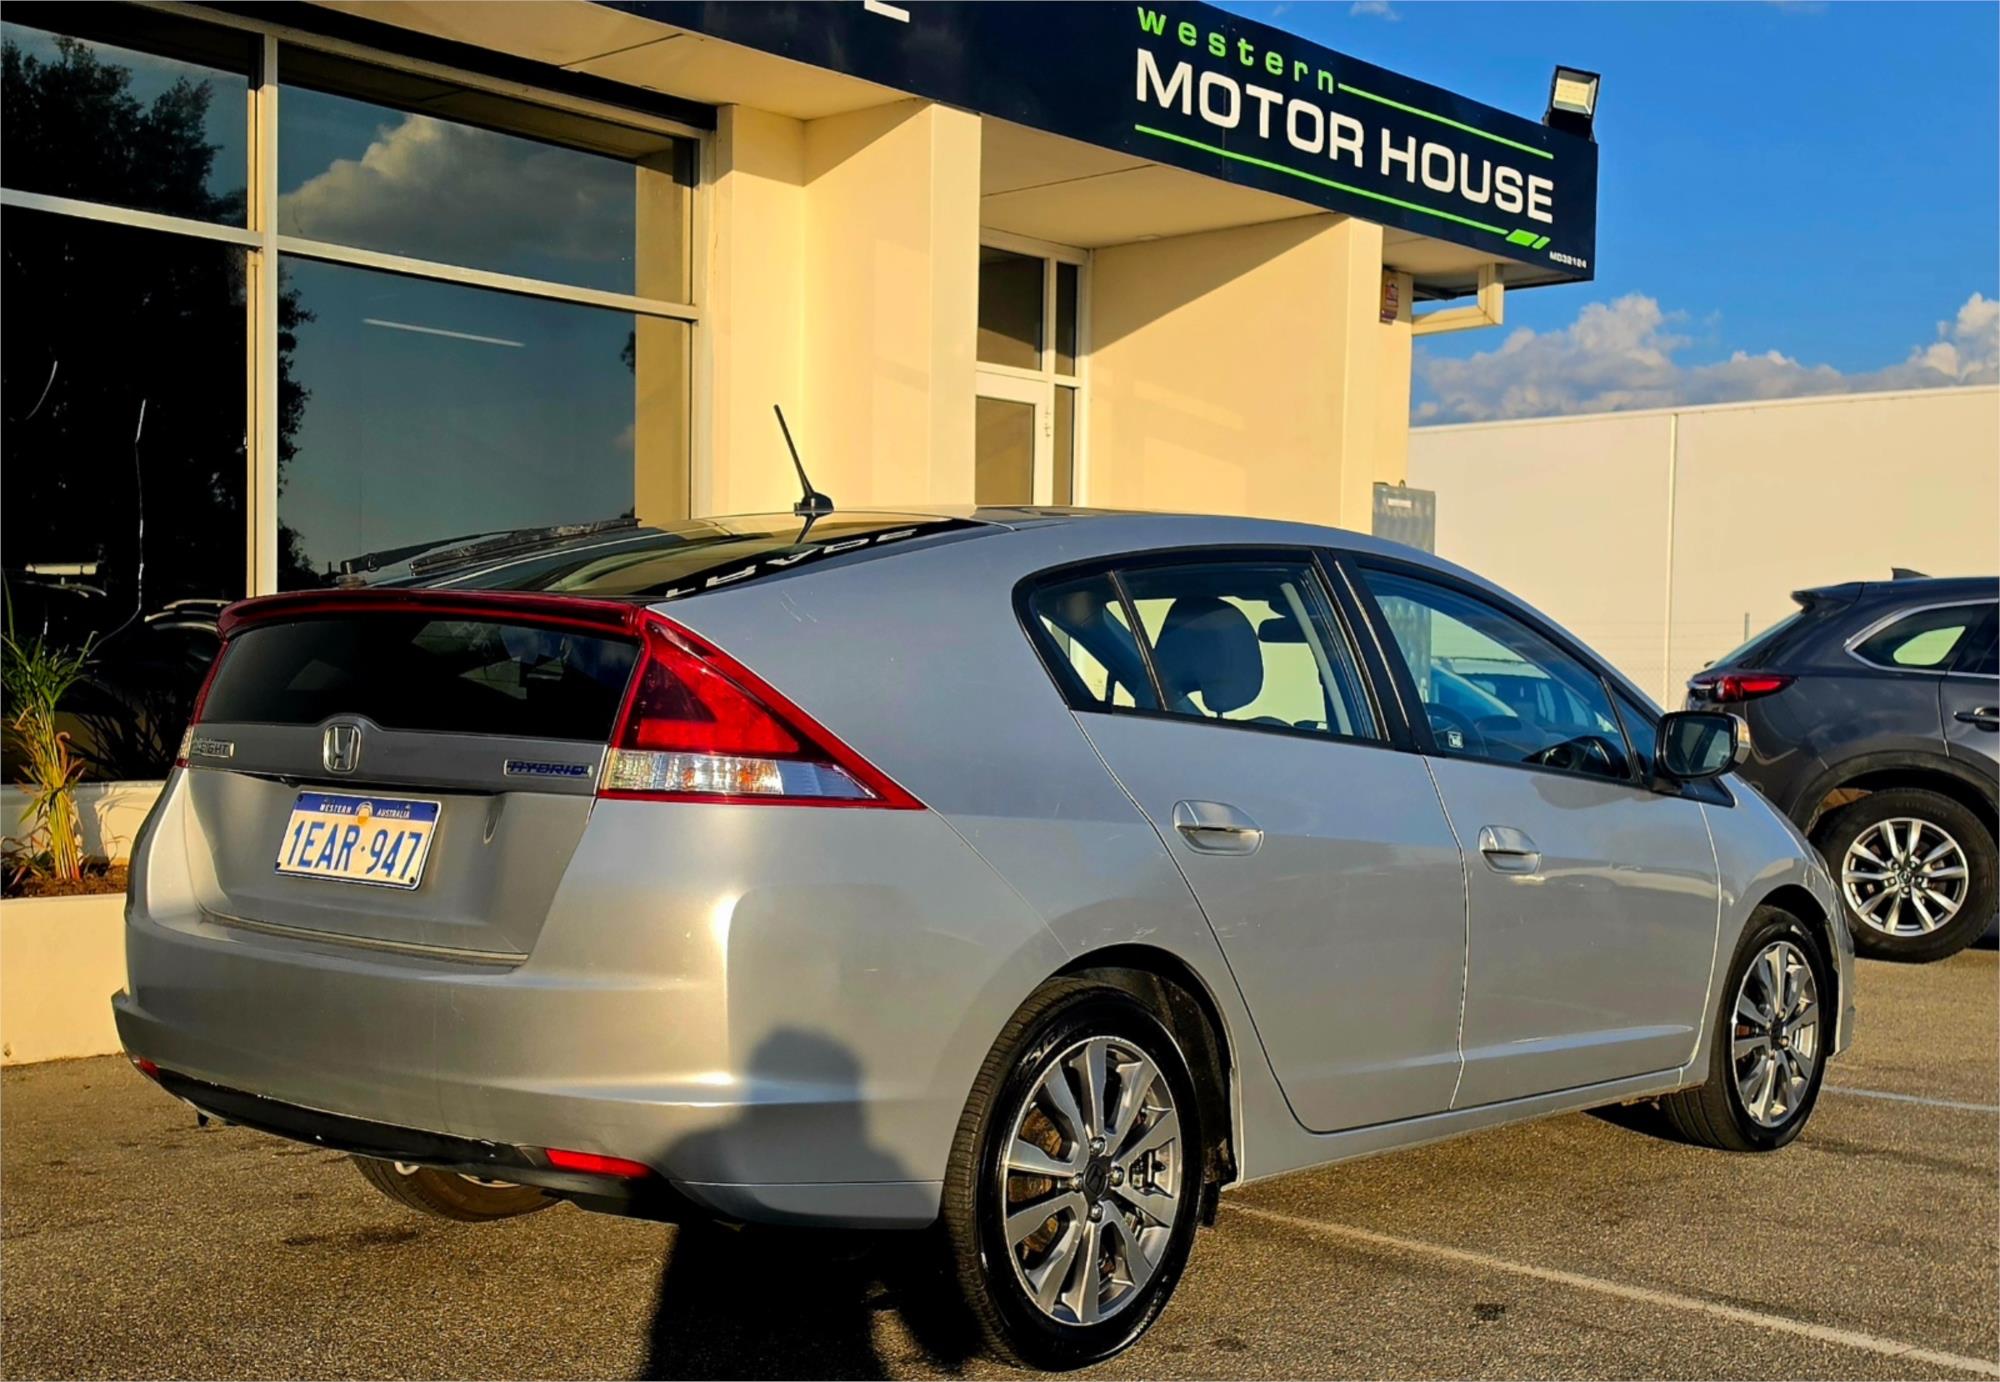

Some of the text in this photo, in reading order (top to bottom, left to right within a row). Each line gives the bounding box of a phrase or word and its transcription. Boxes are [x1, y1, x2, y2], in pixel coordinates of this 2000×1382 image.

[1137, 7, 1335, 95] western
[1136, 48, 1554, 224] MOTOR HOUSE
[510, 761, 586, 776] HYBRID
[319, 803, 411, 819] WESTERN AUSTRALIA
